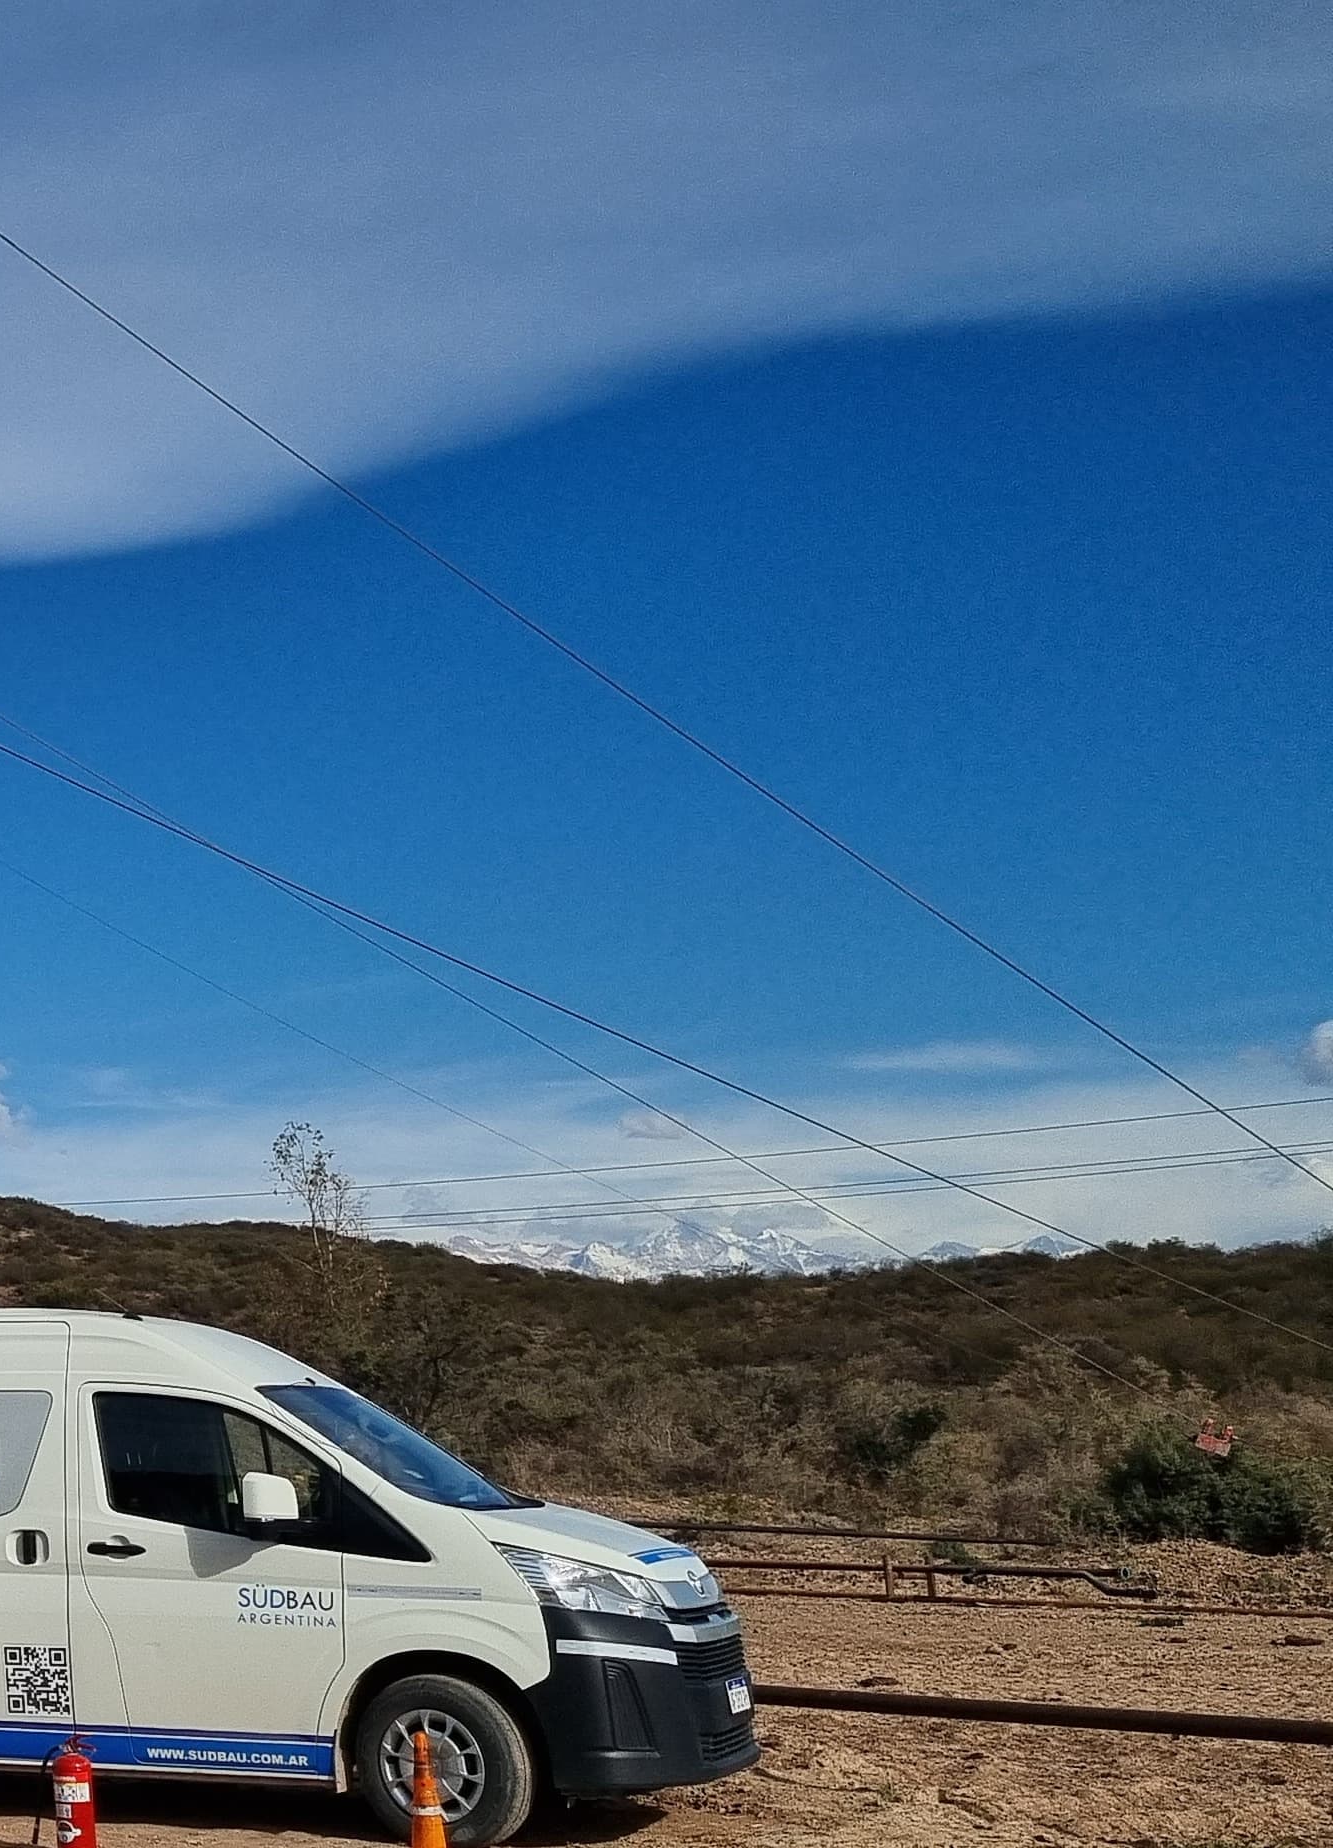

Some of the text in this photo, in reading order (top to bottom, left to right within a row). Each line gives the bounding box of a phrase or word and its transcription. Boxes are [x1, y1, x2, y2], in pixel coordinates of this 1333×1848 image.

[237, 1583, 334, 1612] SÜDBAU
[237, 1612, 336, 1628] ARGENTINA
[146, 1747, 309, 1767] WWW.SUDBAU.COM.AR
